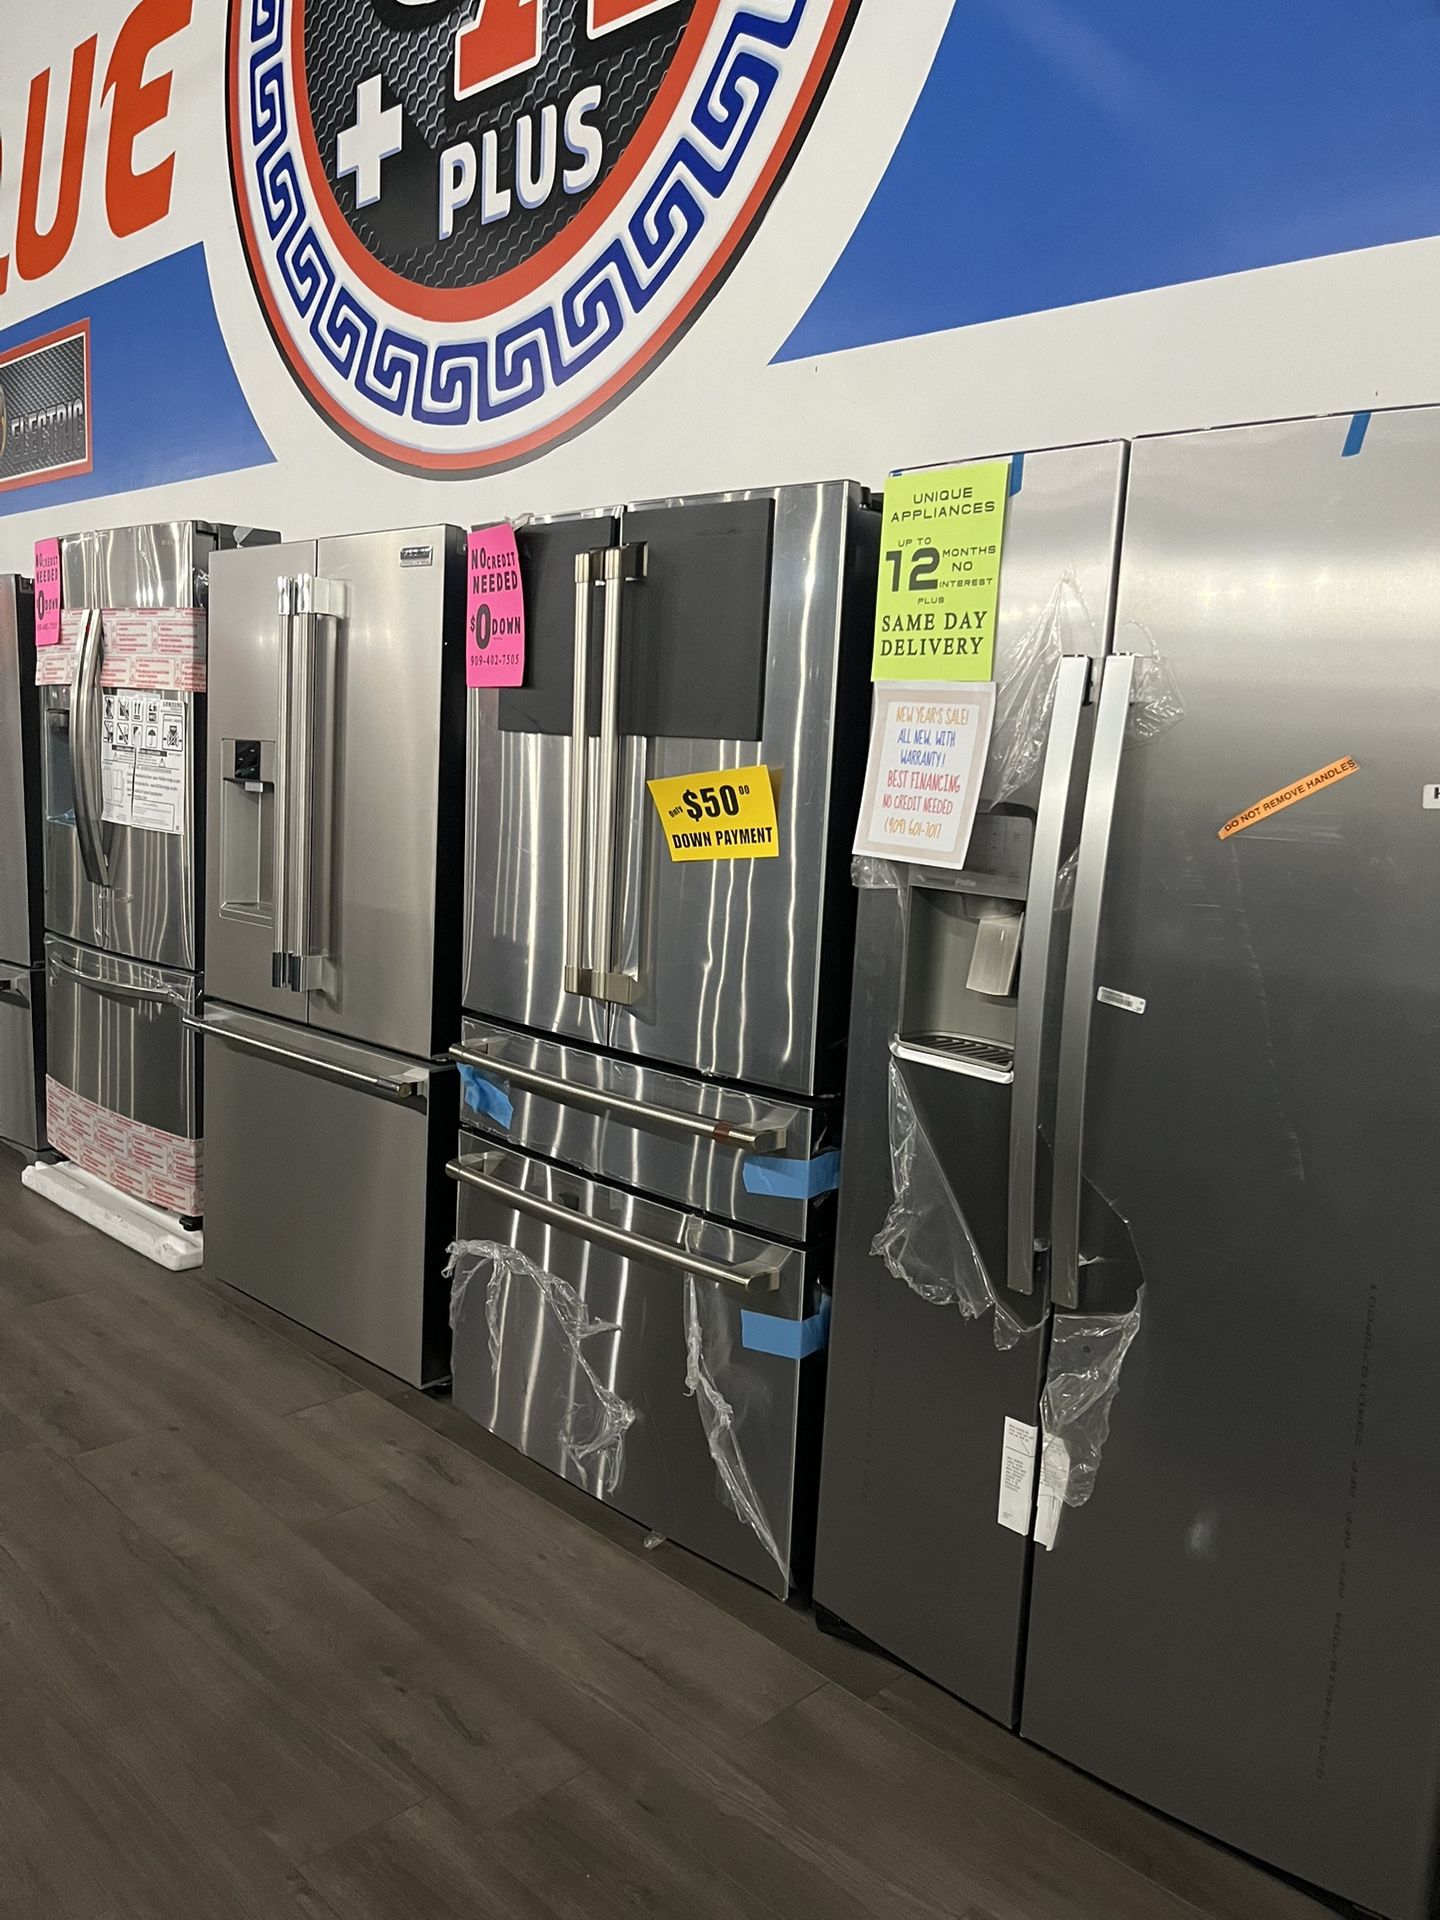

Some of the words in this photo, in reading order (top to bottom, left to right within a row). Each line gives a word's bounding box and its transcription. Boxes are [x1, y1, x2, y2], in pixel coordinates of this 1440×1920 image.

[0, 0, 193, 296] UE
[438, 84, 604, 241] PLUS
[913, 486, 974, 505] UNIQUE
[890, 500, 996, 523] APPLIANCES
[897, 538, 913, 548] UP
[917, 536, 932, 546] TO
[942, 545, 996, 558] MONTHS
[471, 547, 486, 570] NO
[487, 551, 516, 570] CREDIT
[951, 561, 973, 572] NO
[885, 547, 940, 593] 12
[473, 570, 518, 595] NEEDED
[939, 577, 994, 589] INTEREST
[917, 596, 945, 605] PLUS
[491, 616, 521, 636] DOWN
[881, 612, 935, 632] SAME
[943, 611, 988, 630] DAY
[880, 636, 985, 657] DELIVERY
[470, 654, 520, 667] 909-402-7505
[896, 706, 913, 723] NEW
[944, 708, 969, 726] SALE!
[897, 728, 912, 744] ALL
[935, 730, 957, 747] WITH
[887, 769, 909, 788] BEST
[911, 771, 961, 793] FINANCING
[682, 784, 740, 822] $50
[882, 793, 893, 809] NO
[893, 795, 921, 812] CREDIT
[922, 796, 954, 815] NEEDED
[1224, 819, 1240, 832] DO
[1240, 807, 1262, 823] NOT
[1262, 784, 1306, 812] REMOVE
[1305, 759, 1356, 790] HANDLES
[672, 831, 712, 849] DOWN
[715, 826, 773, 846] PAYMENT
